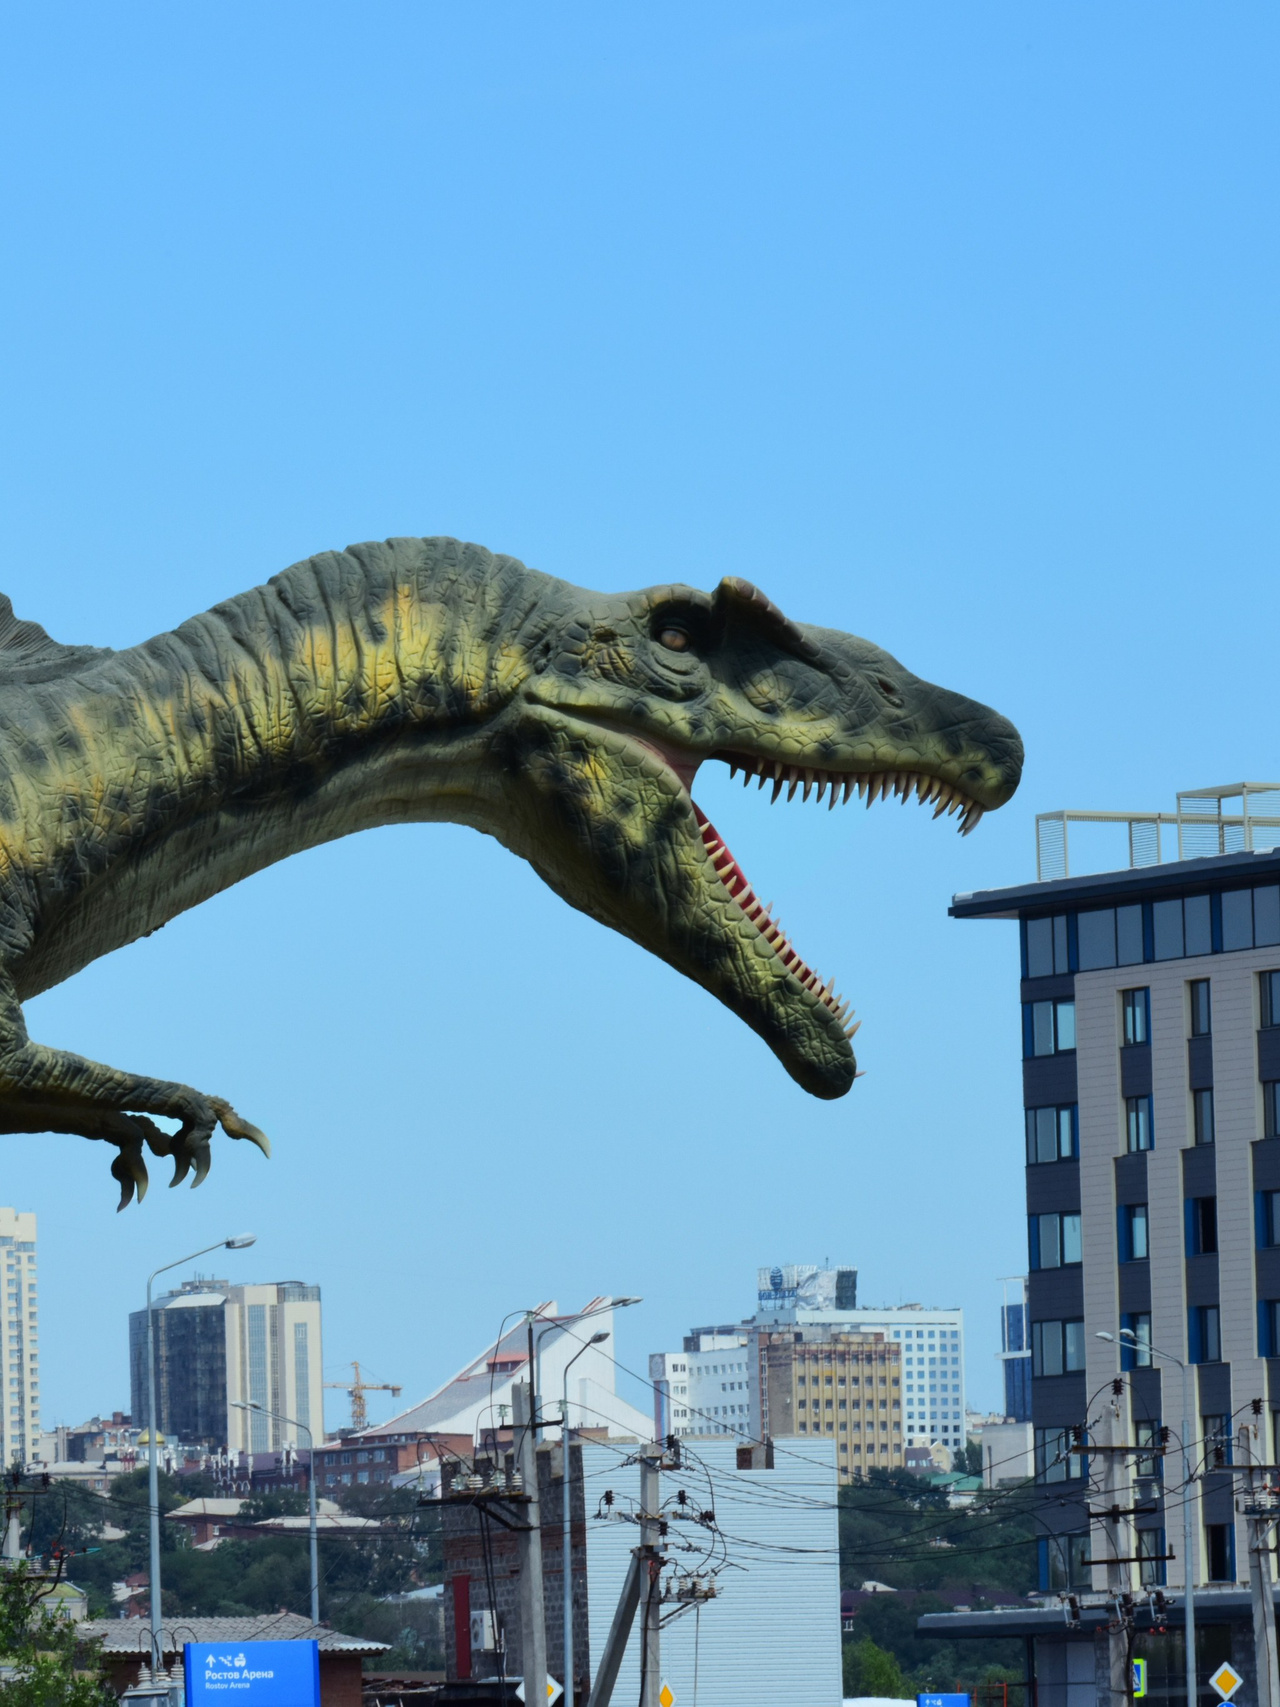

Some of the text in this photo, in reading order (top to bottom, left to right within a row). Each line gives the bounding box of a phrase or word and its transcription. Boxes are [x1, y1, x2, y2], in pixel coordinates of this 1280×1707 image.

[205, 1669, 274, 1681] Ростов Арена
[205, 1681, 250, 1690] Rostov Arena
